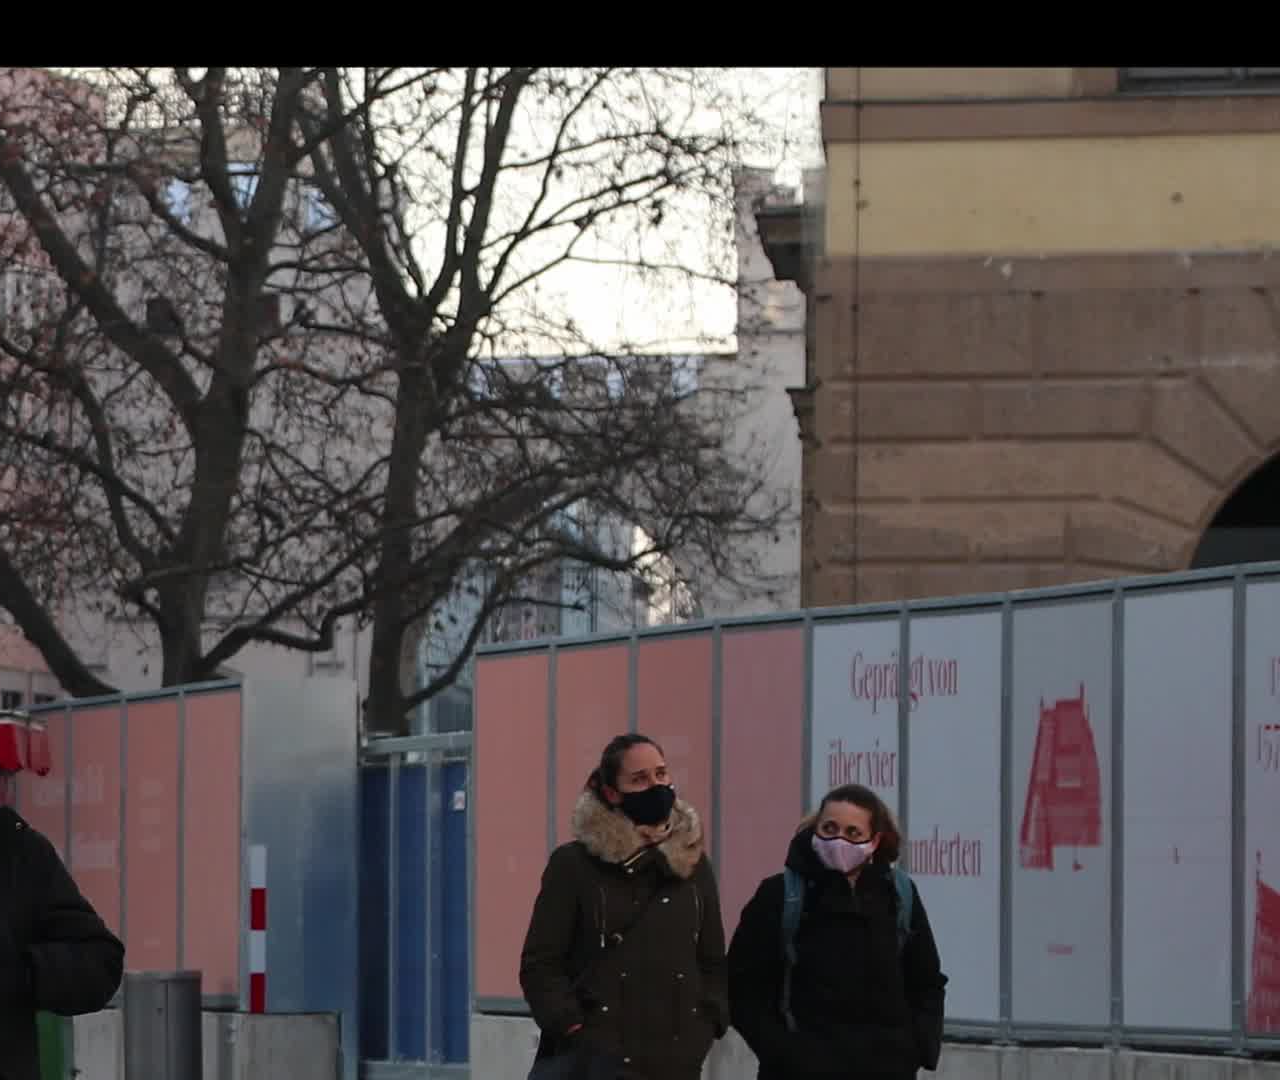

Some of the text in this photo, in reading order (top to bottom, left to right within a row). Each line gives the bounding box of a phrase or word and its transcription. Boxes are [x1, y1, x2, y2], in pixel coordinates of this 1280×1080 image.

[928, 656, 958, 697] von
[828, 738, 897, 788] über vier
